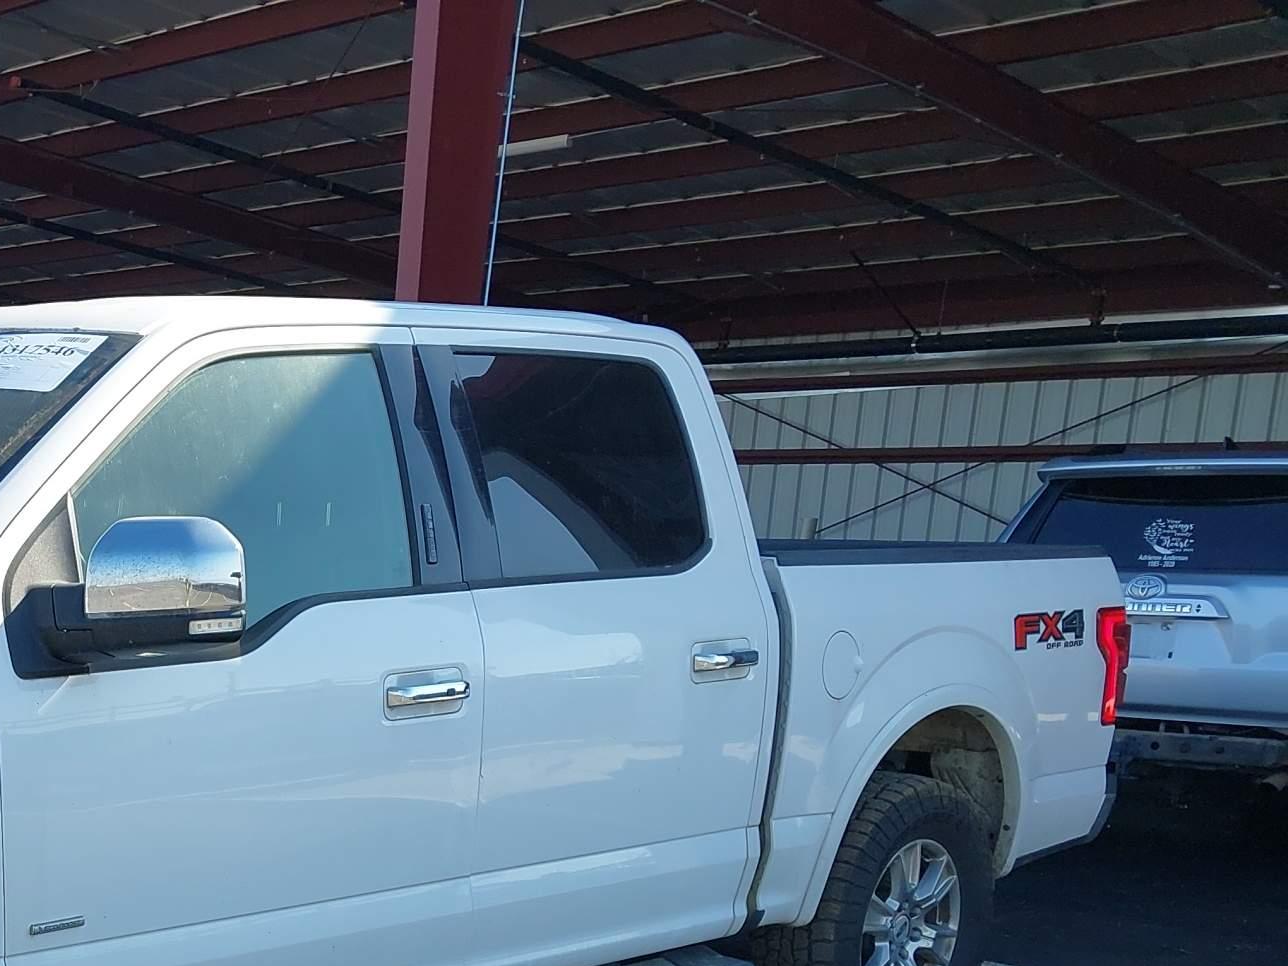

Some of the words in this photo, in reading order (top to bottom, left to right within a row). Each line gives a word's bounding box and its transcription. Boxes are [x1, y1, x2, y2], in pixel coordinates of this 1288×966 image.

[1014, 608, 1085, 651] FX4
[1047, 642, 1062, 650] OFF
[1064, 640, 1084, 648] ROAD
